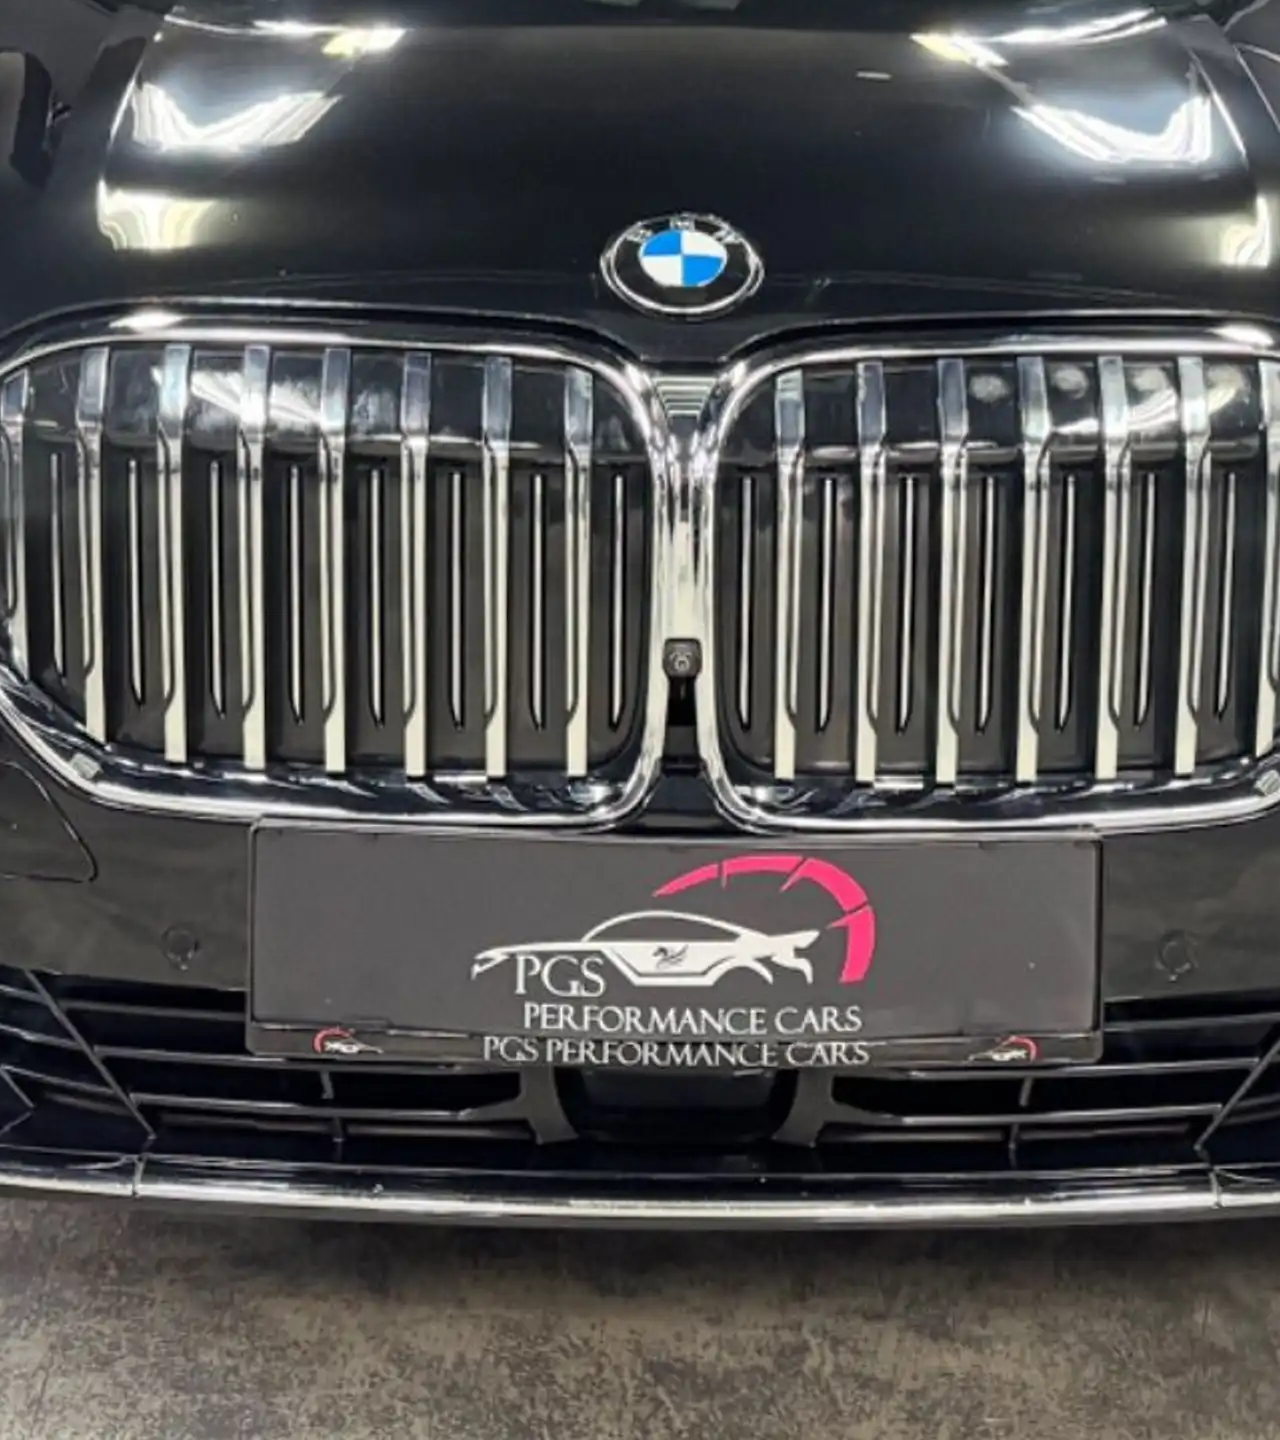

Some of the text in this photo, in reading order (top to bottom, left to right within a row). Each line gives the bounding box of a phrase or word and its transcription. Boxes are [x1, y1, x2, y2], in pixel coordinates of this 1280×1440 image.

[514, 953, 607, 998] PGS
[523, 1001, 863, 1036] PERFORMANCE CARS
[483, 1034, 871, 1068] PGS PERFORMANCE CARS
